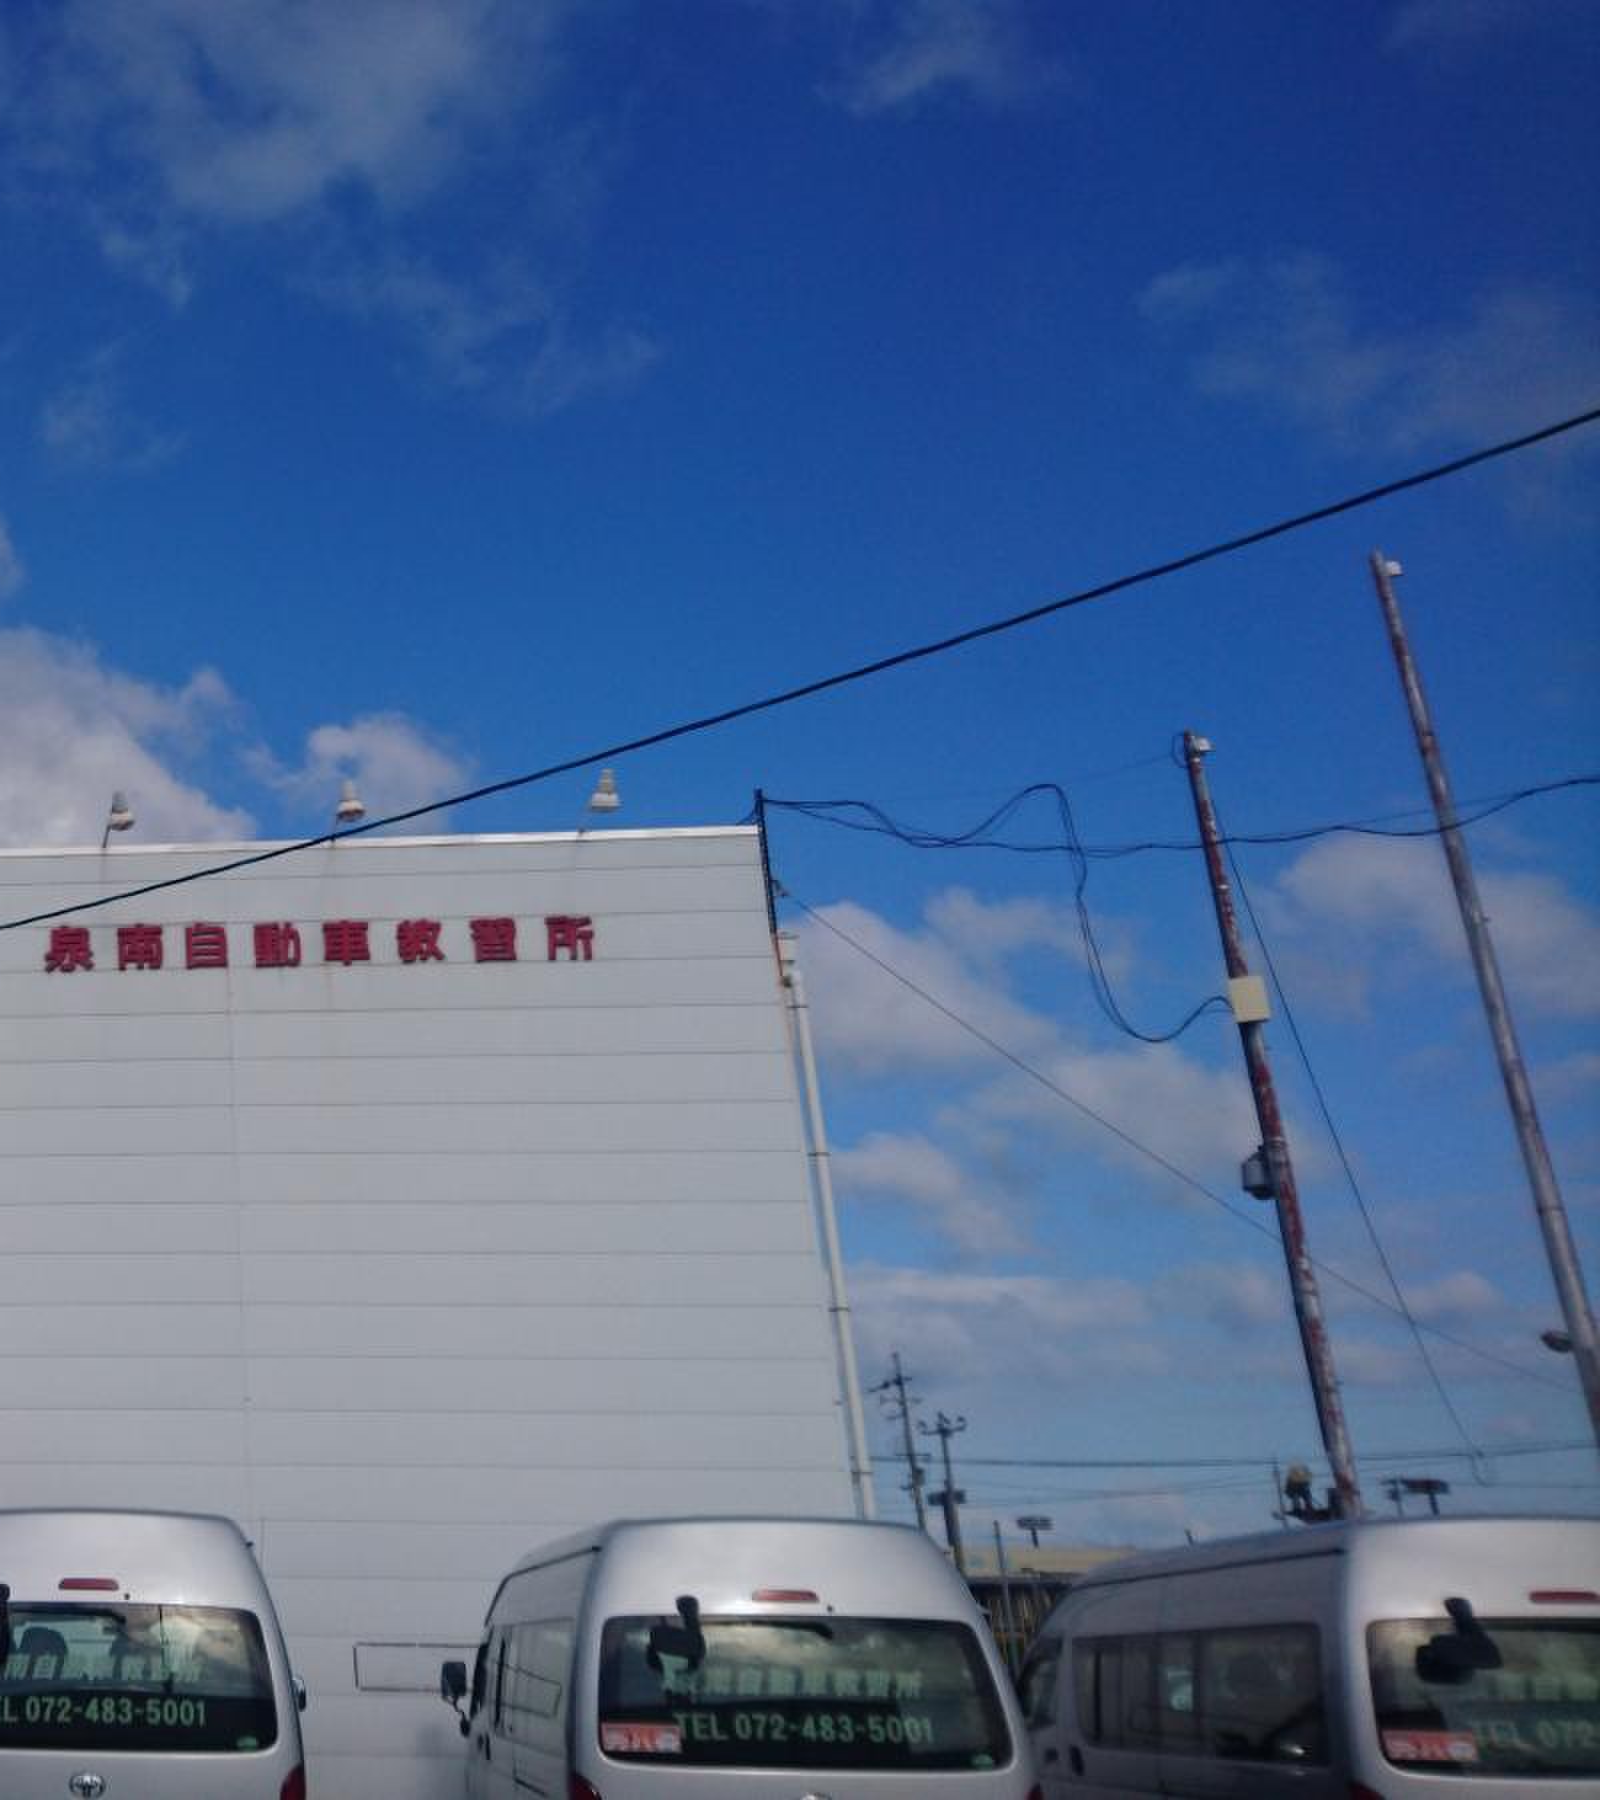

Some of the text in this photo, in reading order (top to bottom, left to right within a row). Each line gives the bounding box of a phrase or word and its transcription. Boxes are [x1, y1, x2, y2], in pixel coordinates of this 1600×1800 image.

[43, 915, 595, 973] 泉南自動車教習所
[25, 1697, 207, 1726] 072-483-5001
[673, 1711, 728, 1741] TEL
[735, 1712, 935, 1745] 072-483-5001
